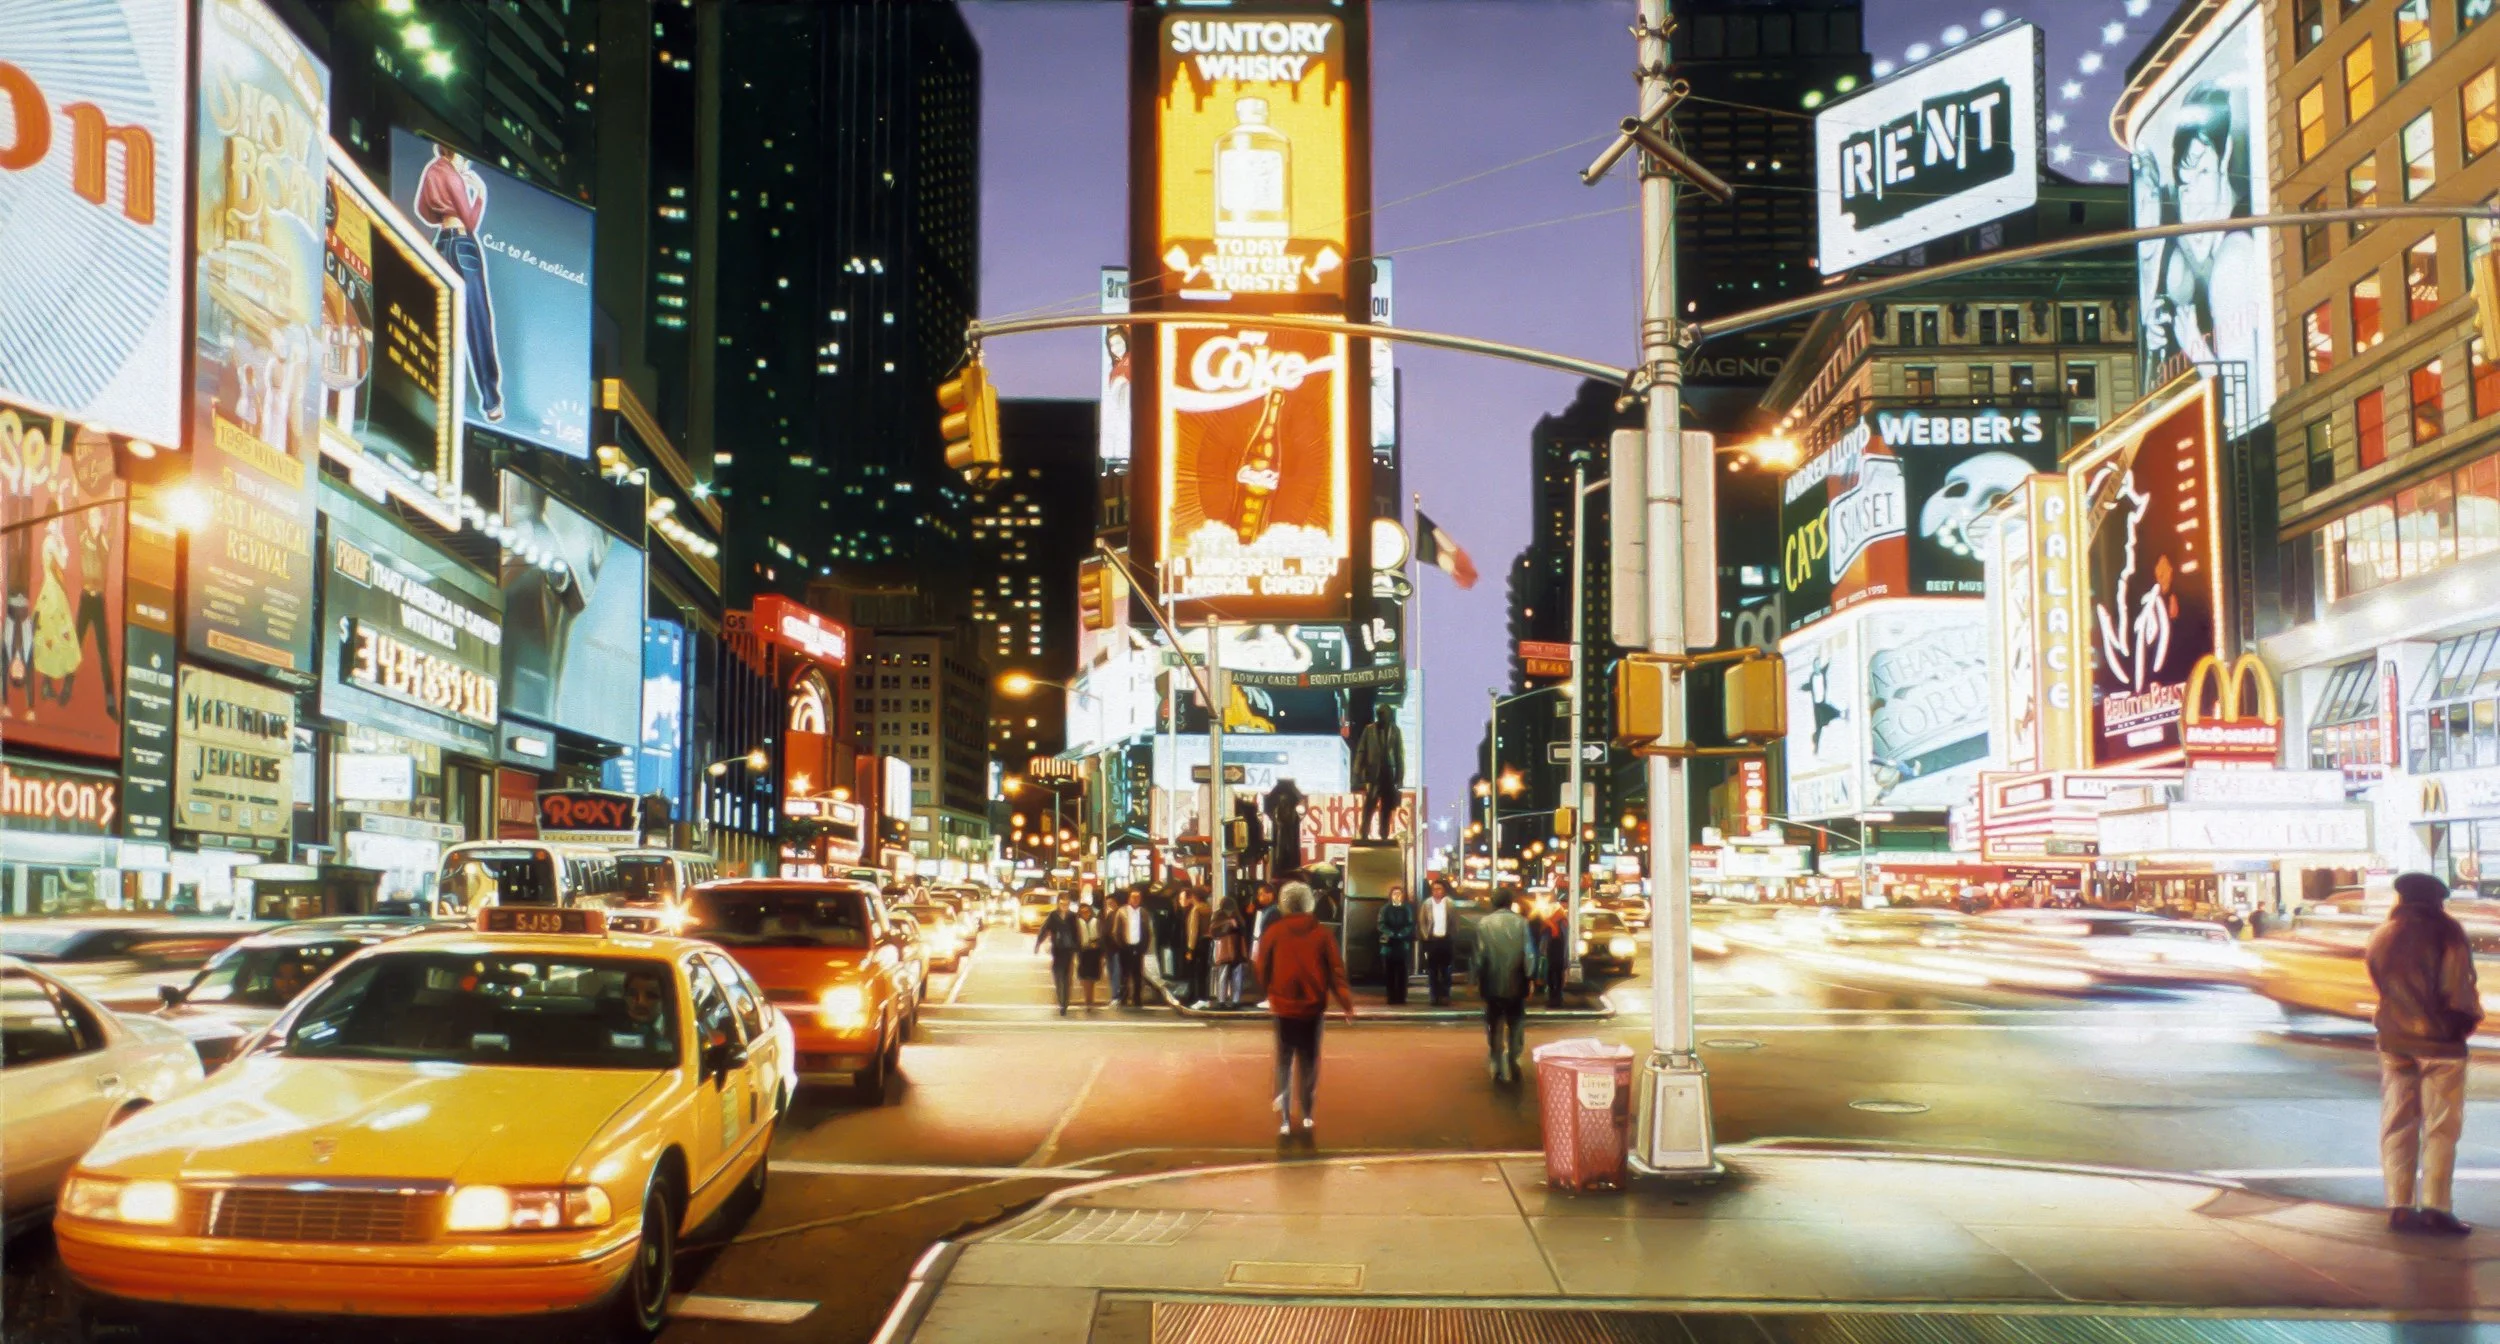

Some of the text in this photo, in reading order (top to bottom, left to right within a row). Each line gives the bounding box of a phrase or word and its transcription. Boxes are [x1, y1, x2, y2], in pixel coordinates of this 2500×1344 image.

[1171, 20, 1333, 53] SUNTORY
[1195, 54, 1308, 81] WHISKY
[1843, 92, 2000, 199] RENT
[483, 233, 588, 286] Cut to be noticed.
[1214, 239, 1288, 257] TODAY
[1202, 256, 1305, 274] SUNTORY
[1211, 275, 1300, 293] TOASTS
[1191, 332, 1308, 392] Coke
[556, 419, 584, 443] Lee
[1879, 416, 2043, 446] WEBBER'S
[1840, 492, 1893, 554] SUNSET
[1785, 506, 1829, 593] CATS
[2044, 495, 2070, 709] PALACE
[1268, 673, 1297, 686] CARES
[1310, 673, 1341, 685] EQUITY
[1344, 670, 1375, 683] FIGHTS
[1378, 667, 1400, 680] AIDS
